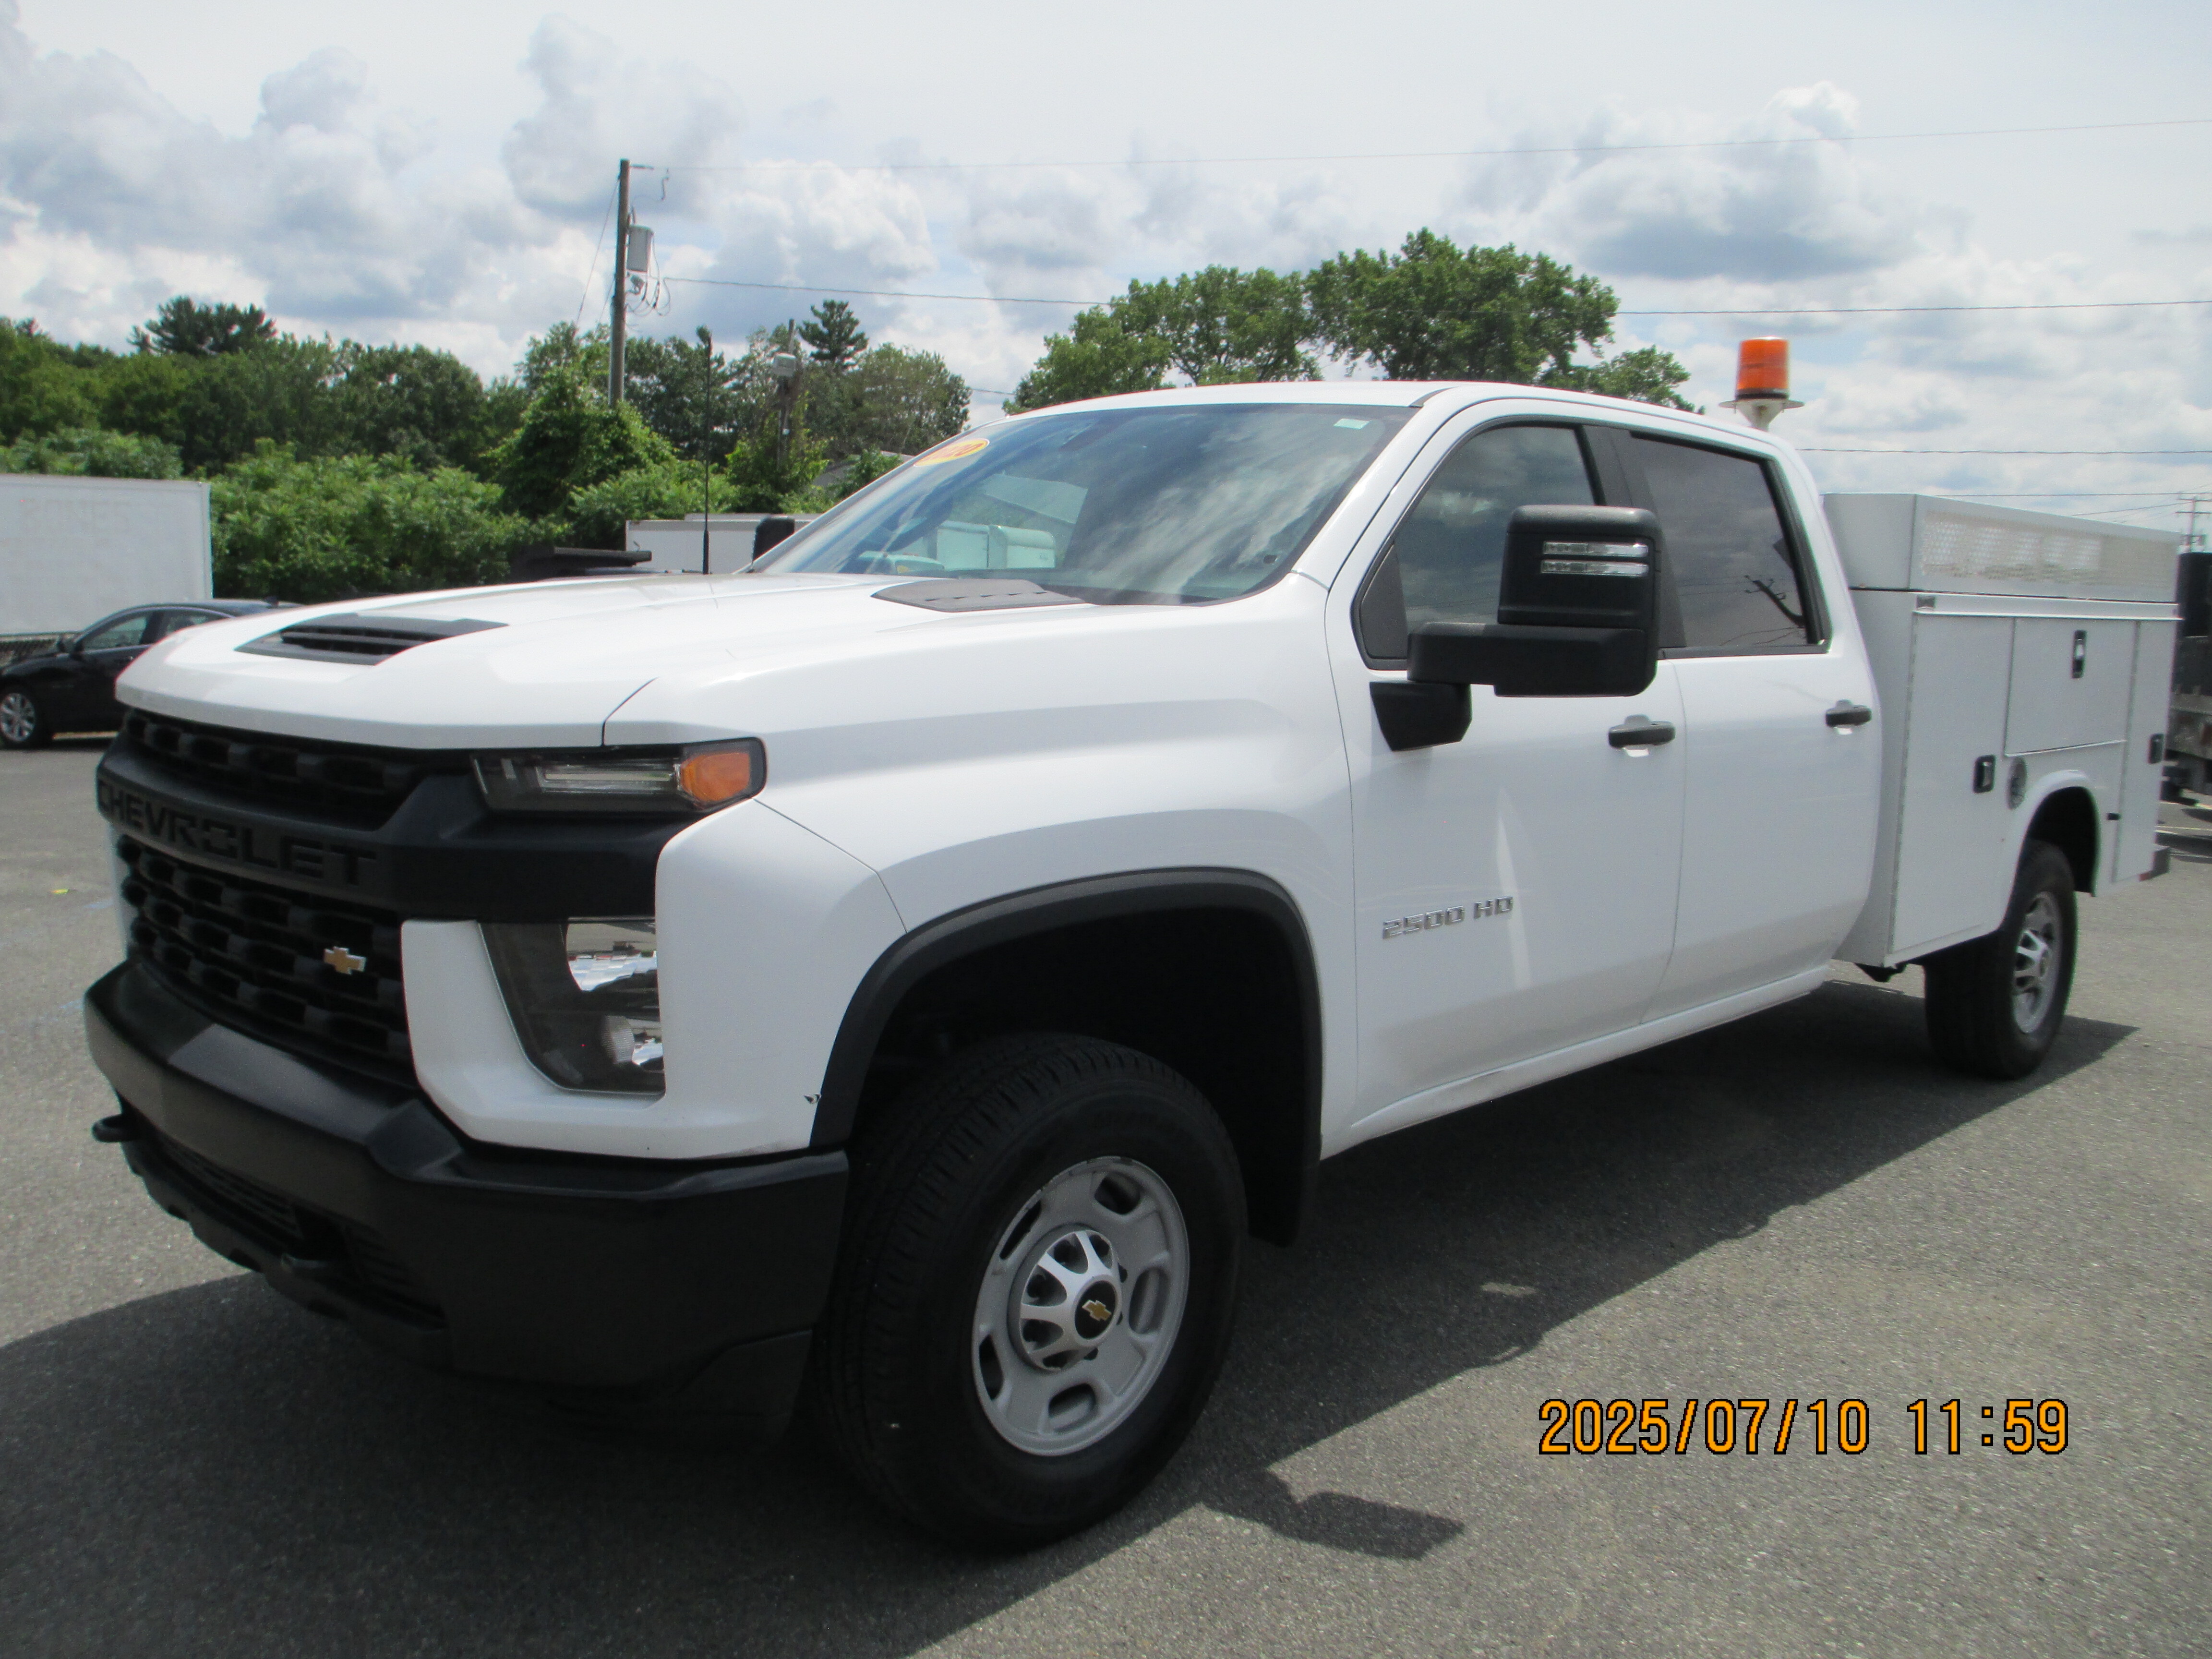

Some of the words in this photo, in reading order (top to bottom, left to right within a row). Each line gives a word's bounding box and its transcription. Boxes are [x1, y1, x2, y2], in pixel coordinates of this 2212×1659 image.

[98, 781, 377, 886] CHEVROLET
[1382, 905, 1465, 938] 2500
[1473, 895, 1514, 919] HD
